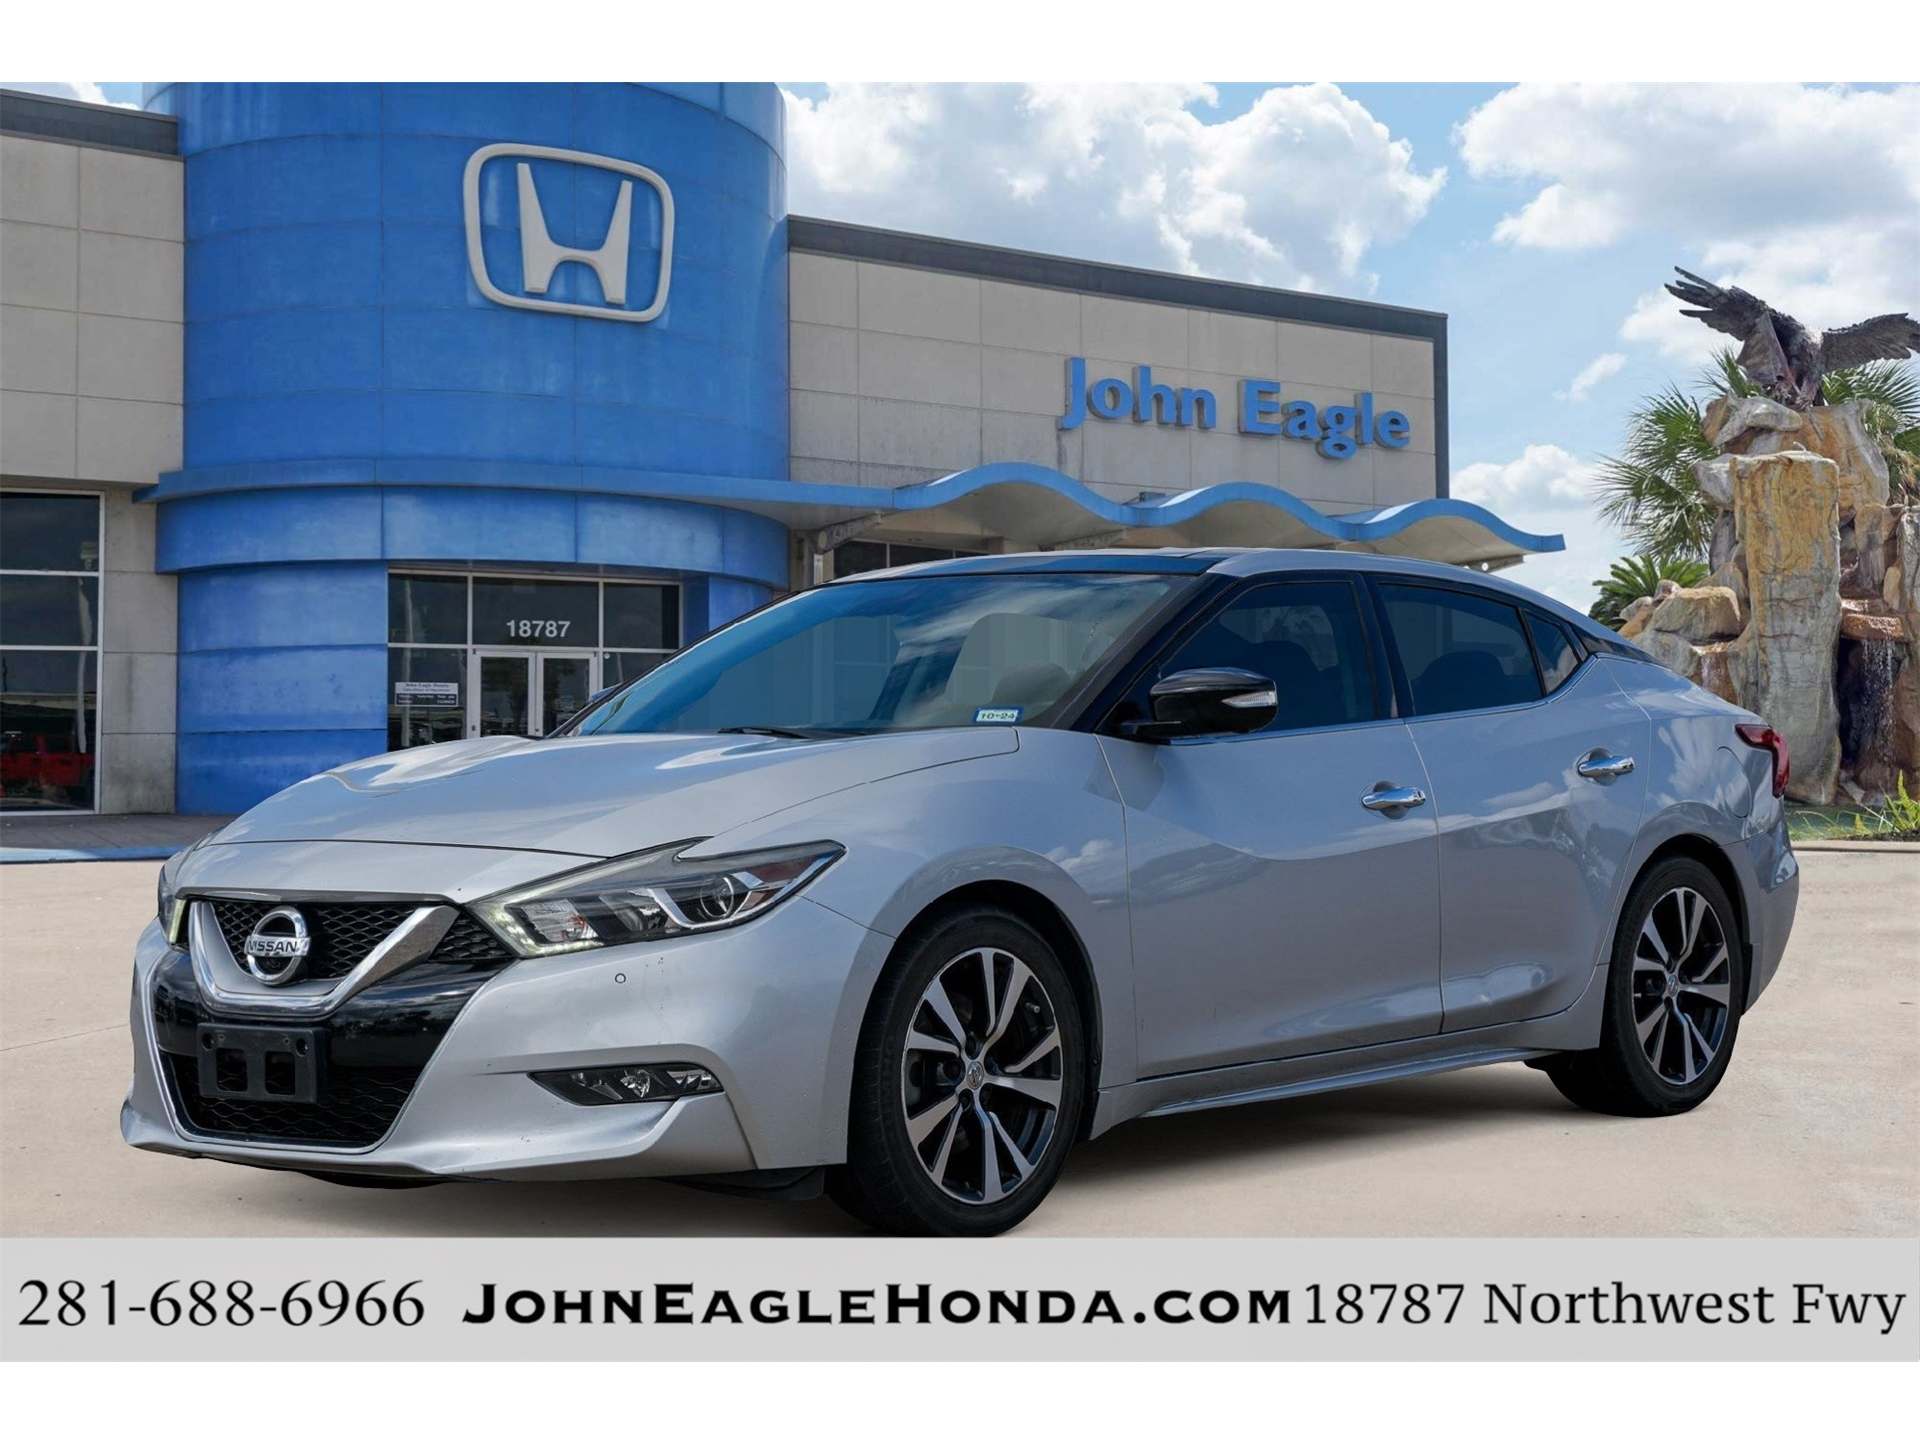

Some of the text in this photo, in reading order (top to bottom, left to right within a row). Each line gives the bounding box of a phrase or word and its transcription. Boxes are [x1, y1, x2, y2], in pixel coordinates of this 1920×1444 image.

[1057, 356, 1411, 460] John Eagle
[506, 619, 571, 638] 18787
[980, 711, 1016, 720] 10-24
[248, 940, 298, 953] NISSAN
